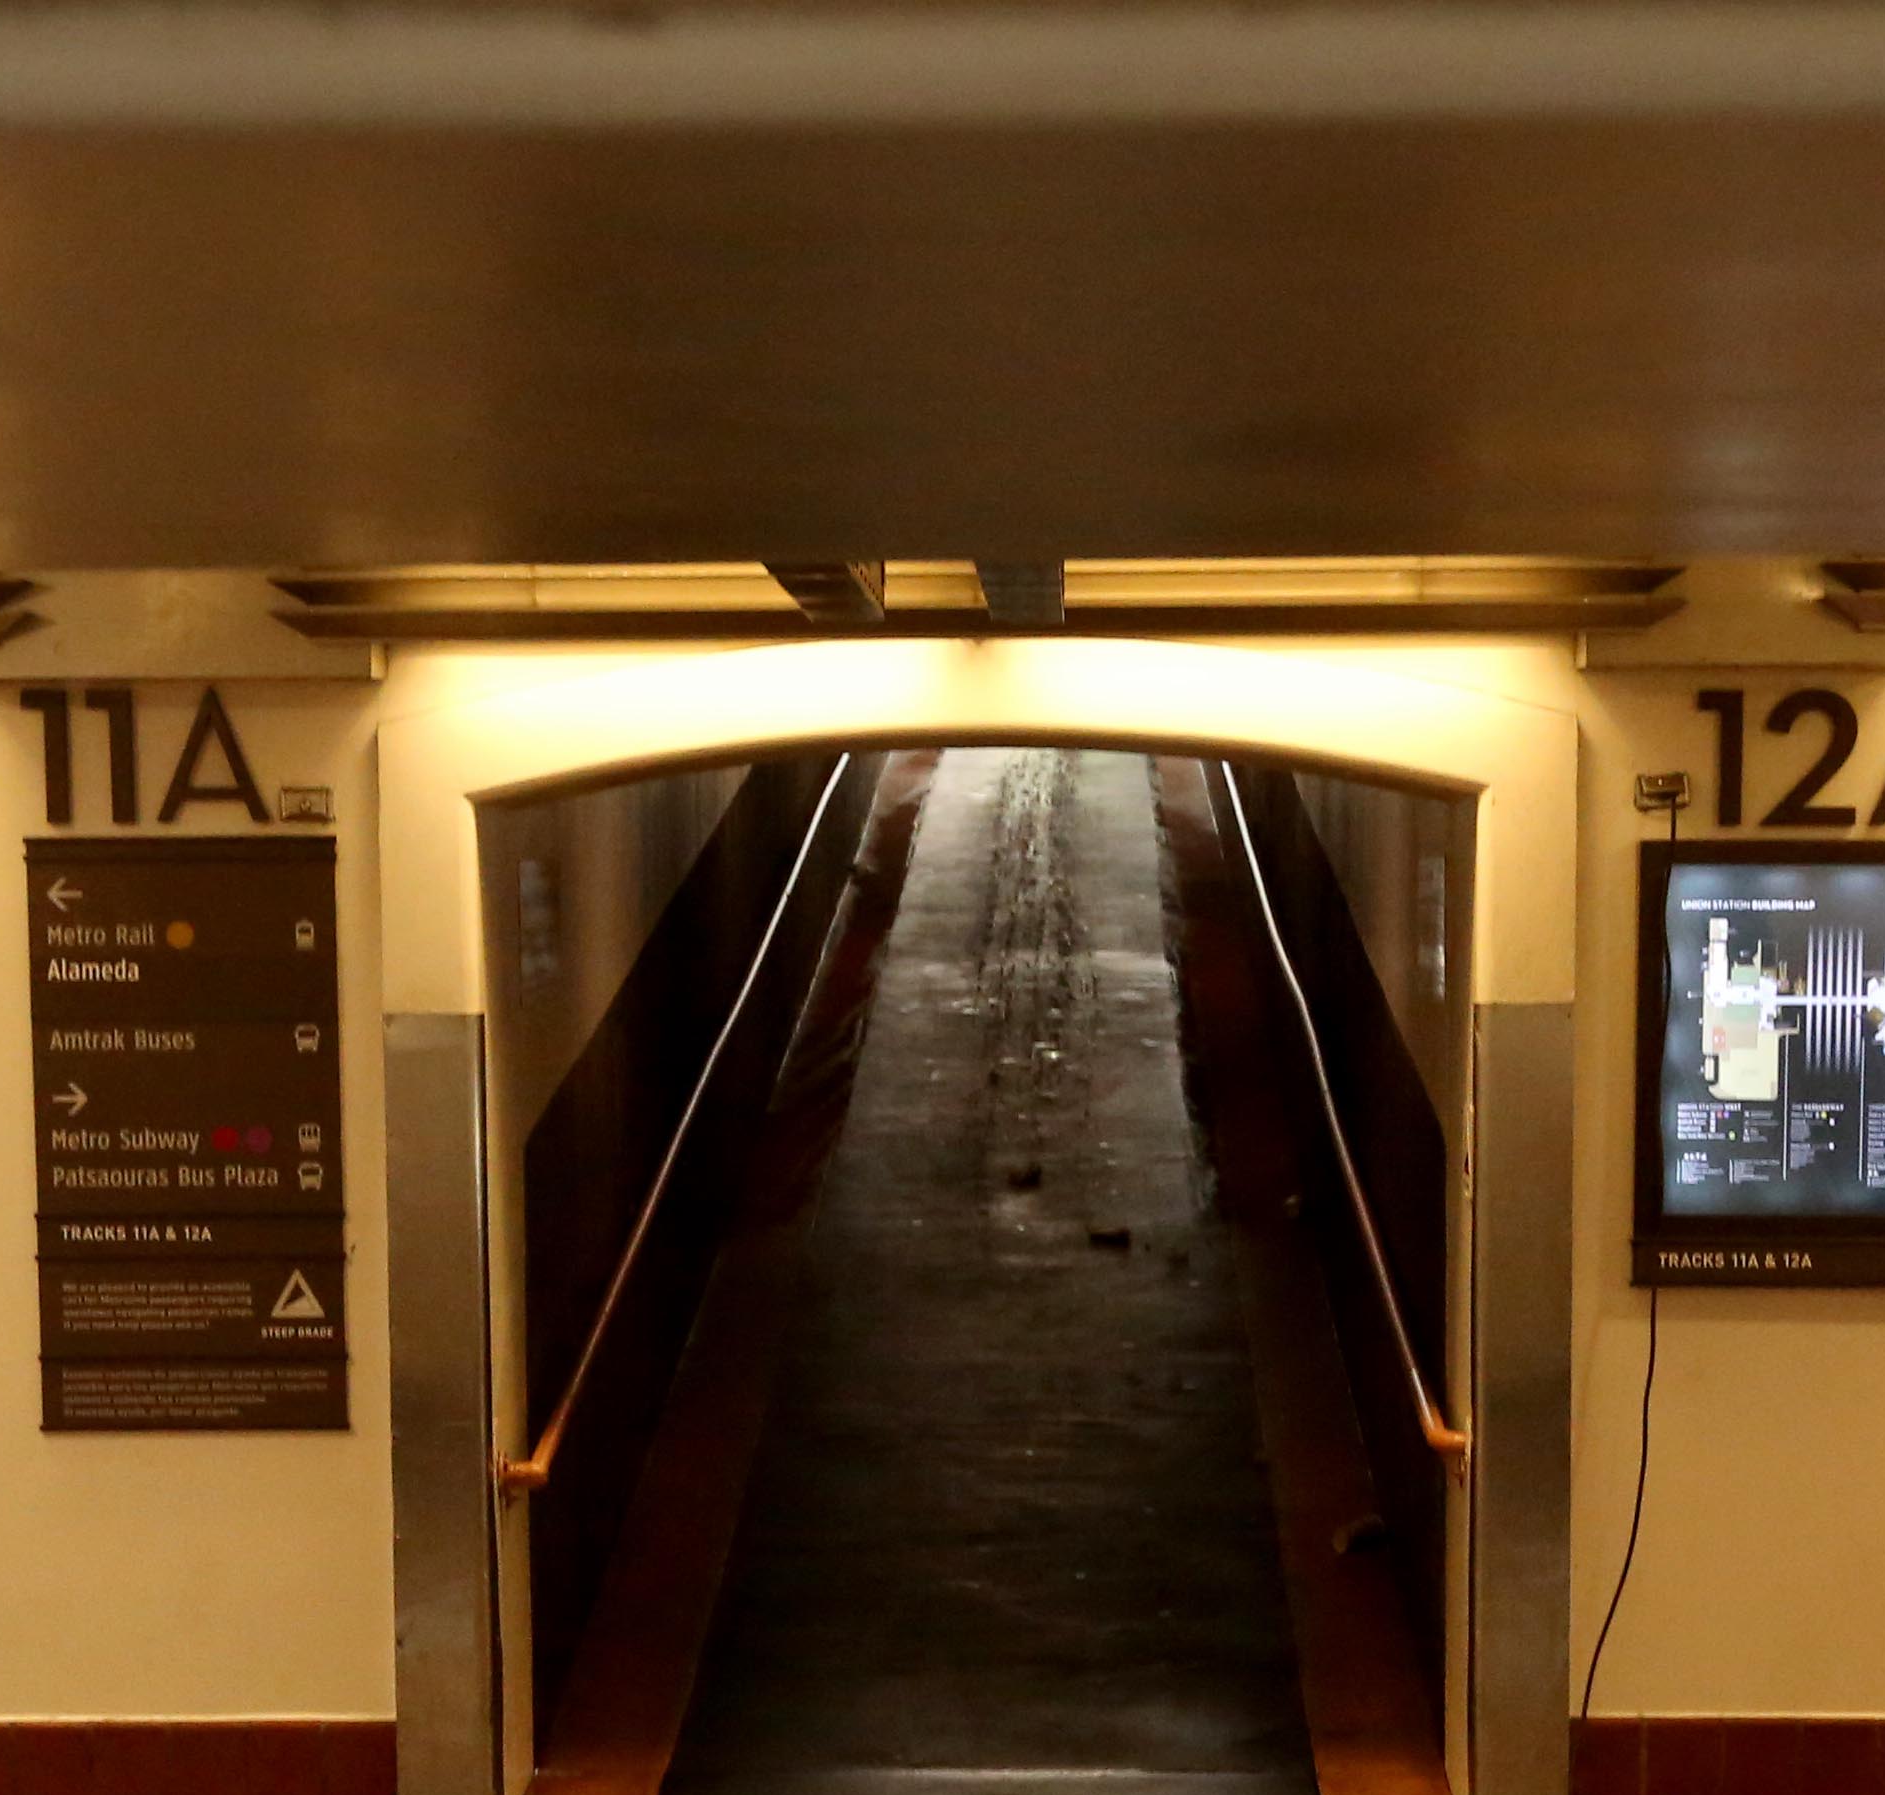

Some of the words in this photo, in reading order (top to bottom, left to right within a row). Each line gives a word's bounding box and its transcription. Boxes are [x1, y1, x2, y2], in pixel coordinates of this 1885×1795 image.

[20, 685, 271, 824] 11A
[47, 924, 106, 946] Metro
[114, 924, 155, 946] Rail
[47, 957, 140, 983] Alameda
[49, 1028, 125, 1051] Amtrak
[134, 1029, 196, 1050] Buses
[51, 1128, 110, 1151] Metro
[119, 1127, 200, 1155] Subway
[53, 1166, 169, 1188] Patsaouras
[178, 1166, 215, 1188] Bus
[224, 1164, 280, 1188] Plaza
[61, 1225, 127, 1242] TRACKS
[133, 1225, 161, 1242] 11A
[165, 1226, 177, 1242] &
[184, 1226, 213, 1242] 12A
[1659, 1252, 1726, 1270] TRACKS
[1732, 1252, 1760, 1269] 11A
[1764, 1253, 1777, 1269] &
[1783, 1252, 1813, 1269] 12A
